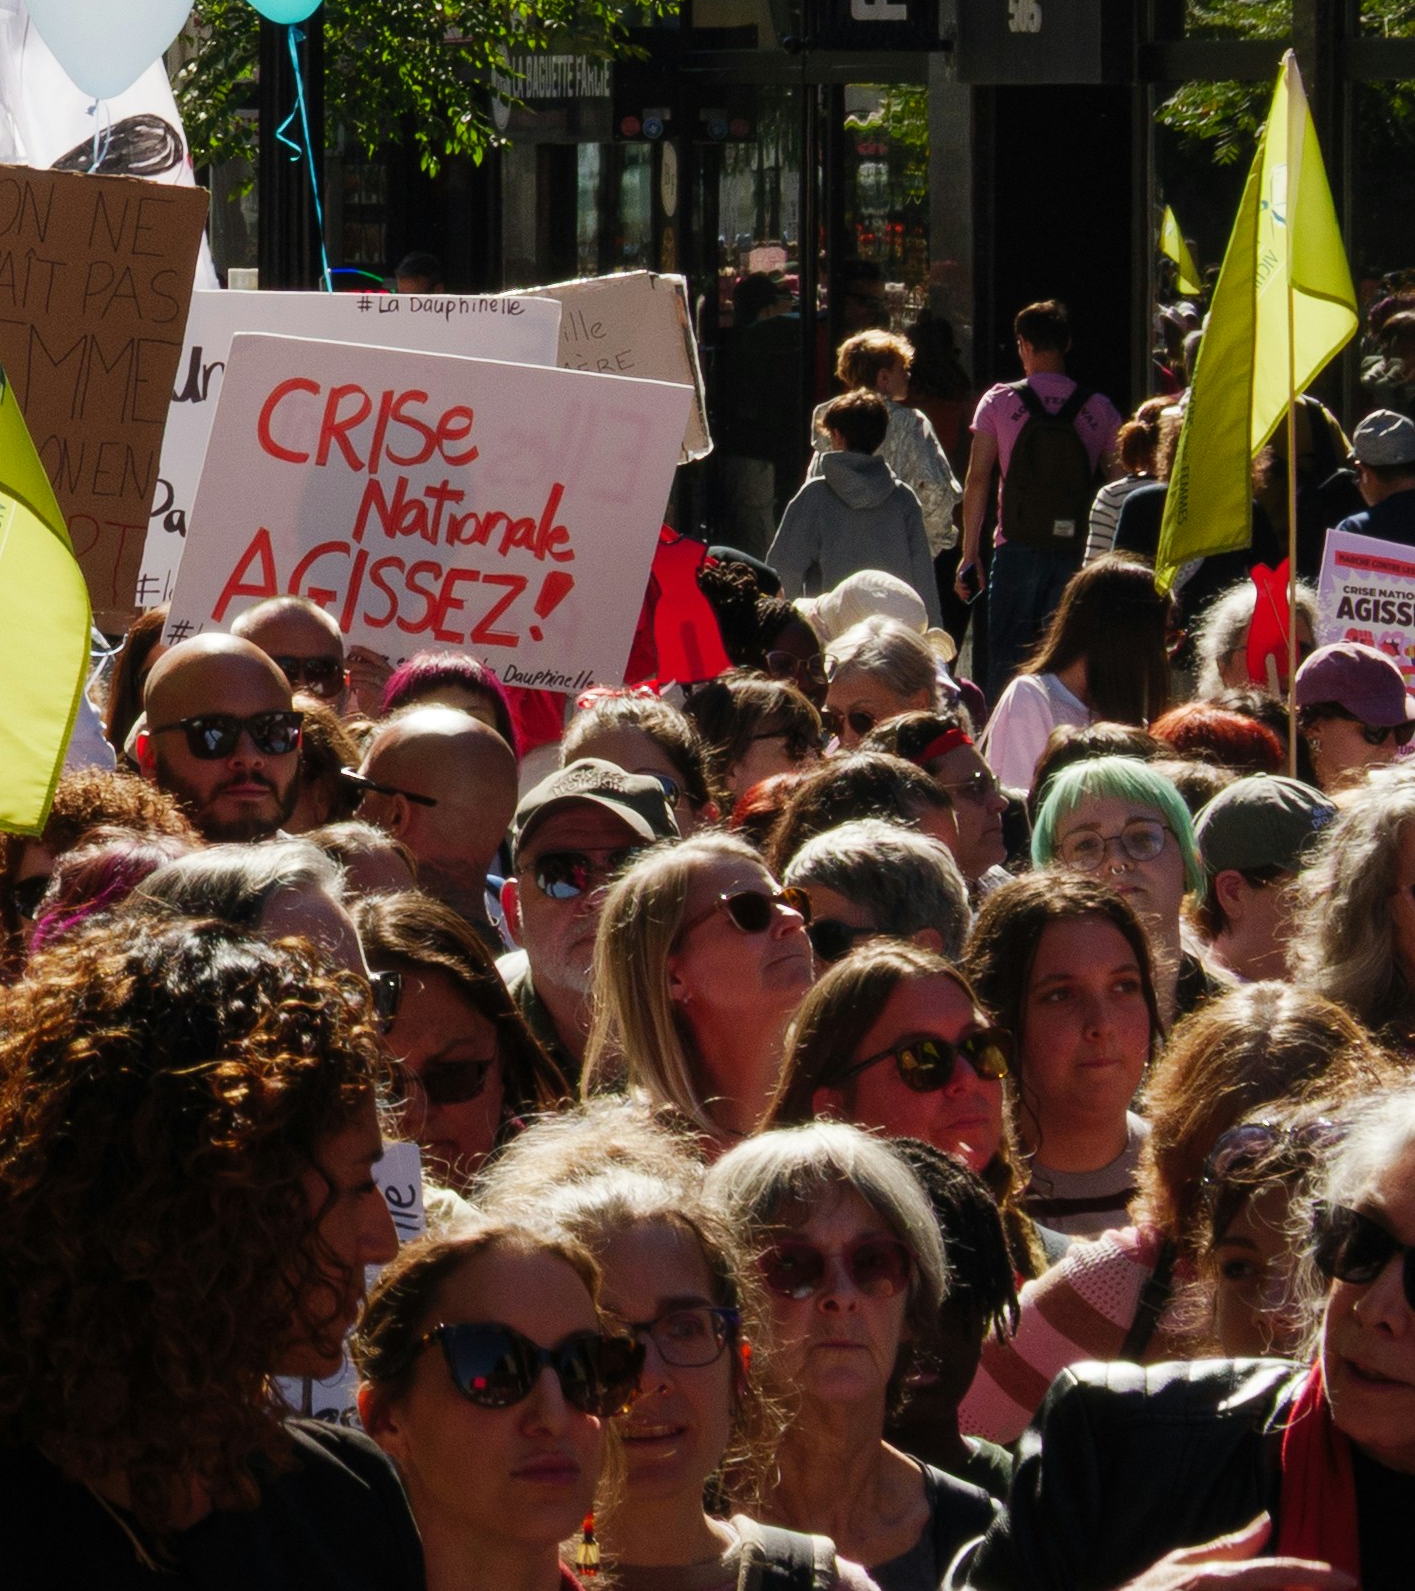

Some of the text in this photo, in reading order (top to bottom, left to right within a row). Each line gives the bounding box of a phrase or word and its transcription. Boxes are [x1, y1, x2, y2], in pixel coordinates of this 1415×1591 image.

[87, 190, 174, 257] NE
[82, 260, 180, 324] PAS
[409, 296, 527, 322] Dauphinelle
[92, 442, 155, 502] EN
[210, 527, 576, 648] AGISSEZ!
[1336, 596, 1415, 627] AGISS
[1343, 585, 1415, 601] CRISE NATIO
